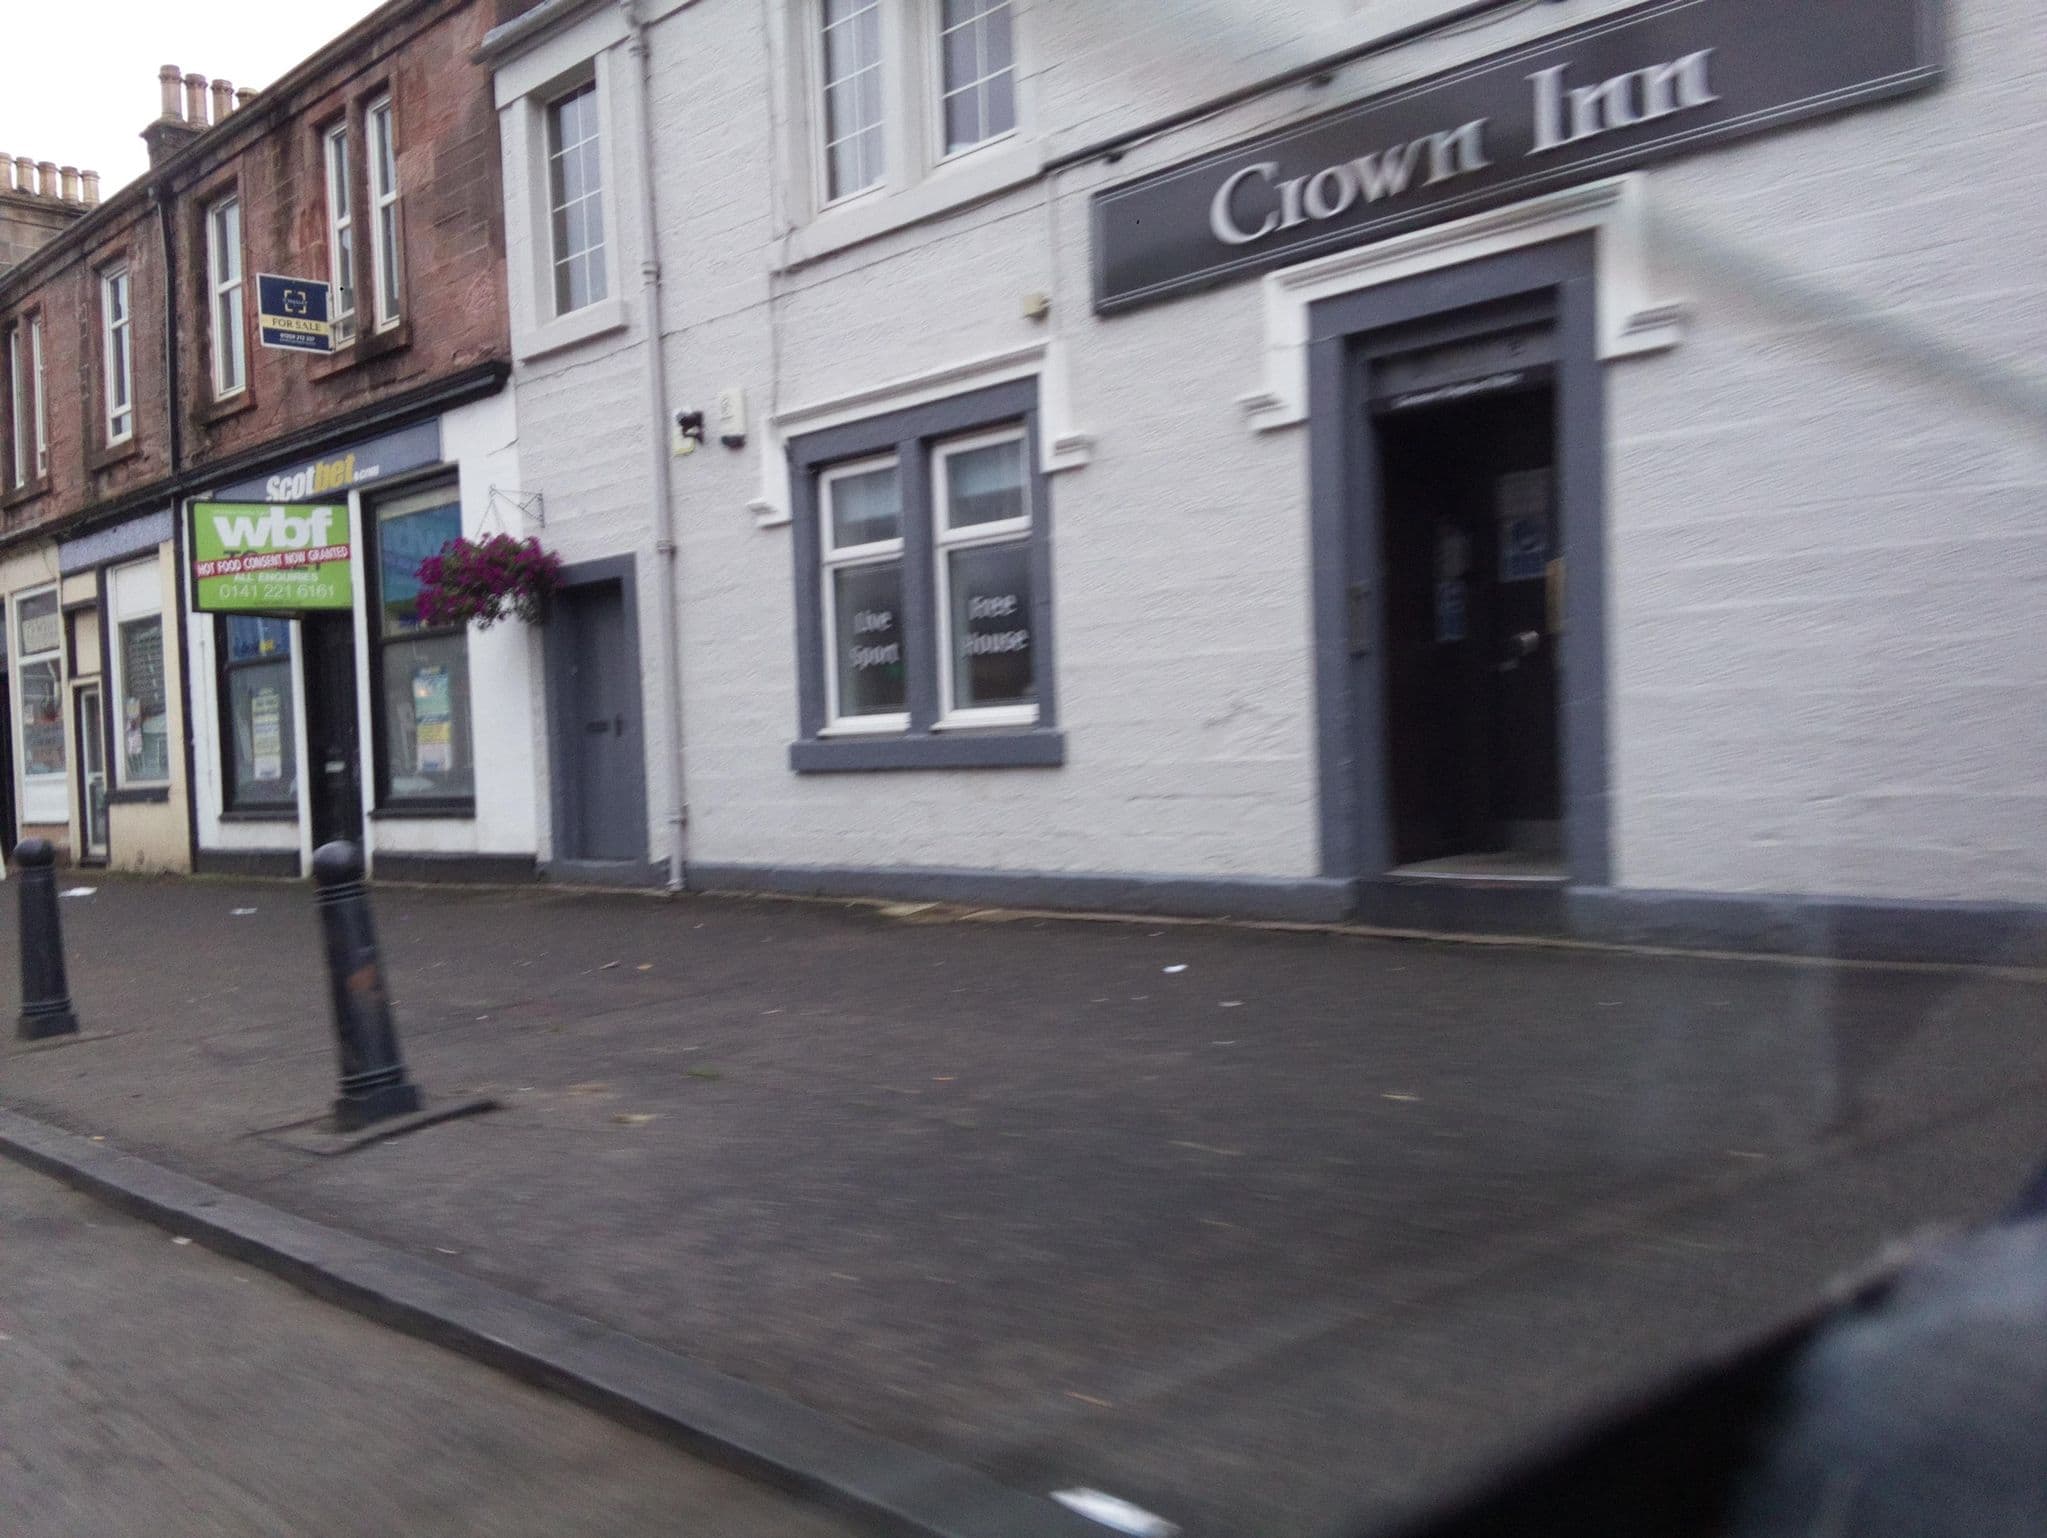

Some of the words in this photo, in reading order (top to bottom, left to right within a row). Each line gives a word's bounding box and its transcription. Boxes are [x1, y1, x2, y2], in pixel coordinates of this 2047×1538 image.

[1209, 116, 1495, 246] Crown
[1524, 48, 1721, 158] Inn
[272, 317, 293, 328] FOR
[295, 320, 321, 332] SALE
[213, 506, 333, 548] wbf
[197, 562, 215, 576] HOT
[217, 559, 242, 573] FOOD
[244, 553, 282, 570] CONSENT
[285, 551, 305, 566] NOW
[308, 546, 348, 561] GRANTED
[234, 573, 254, 583] ALL
[258, 572, 319, 583] ENQUIRIES
[219, 584, 258, 598] 0141
[263, 583, 292, 599] 221
[297, 583, 335, 599] 6161
